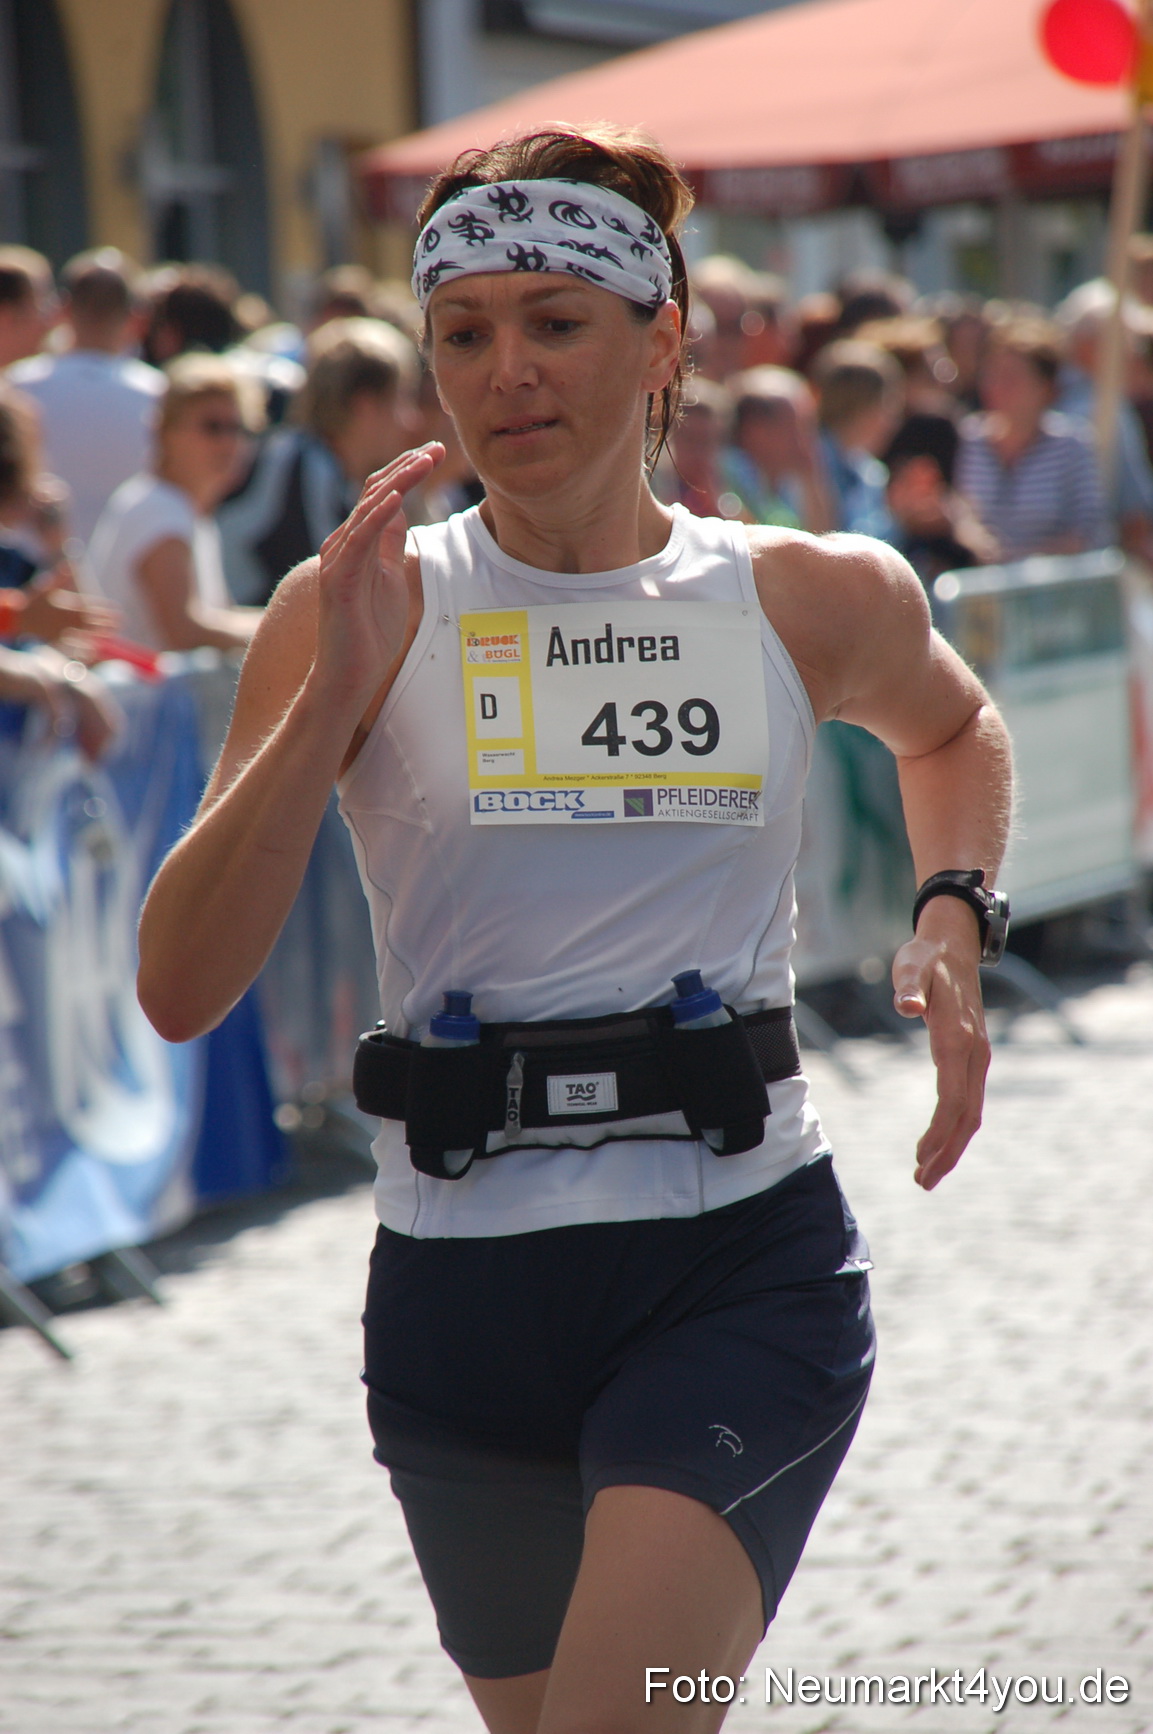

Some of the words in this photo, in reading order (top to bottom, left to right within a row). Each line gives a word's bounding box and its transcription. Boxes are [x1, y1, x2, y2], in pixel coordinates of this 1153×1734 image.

[466, 634, 519, 647] DRUCK
[546, 623, 680, 667] Andrea
[480, 693, 498, 720] D
[581, 698, 721, 757] 439
[474, 790, 586, 813] BOCK
[657, 788, 760, 810] PFLEIDERER
[658, 808, 759, 822] AKTIENGESELLSCHAFT
